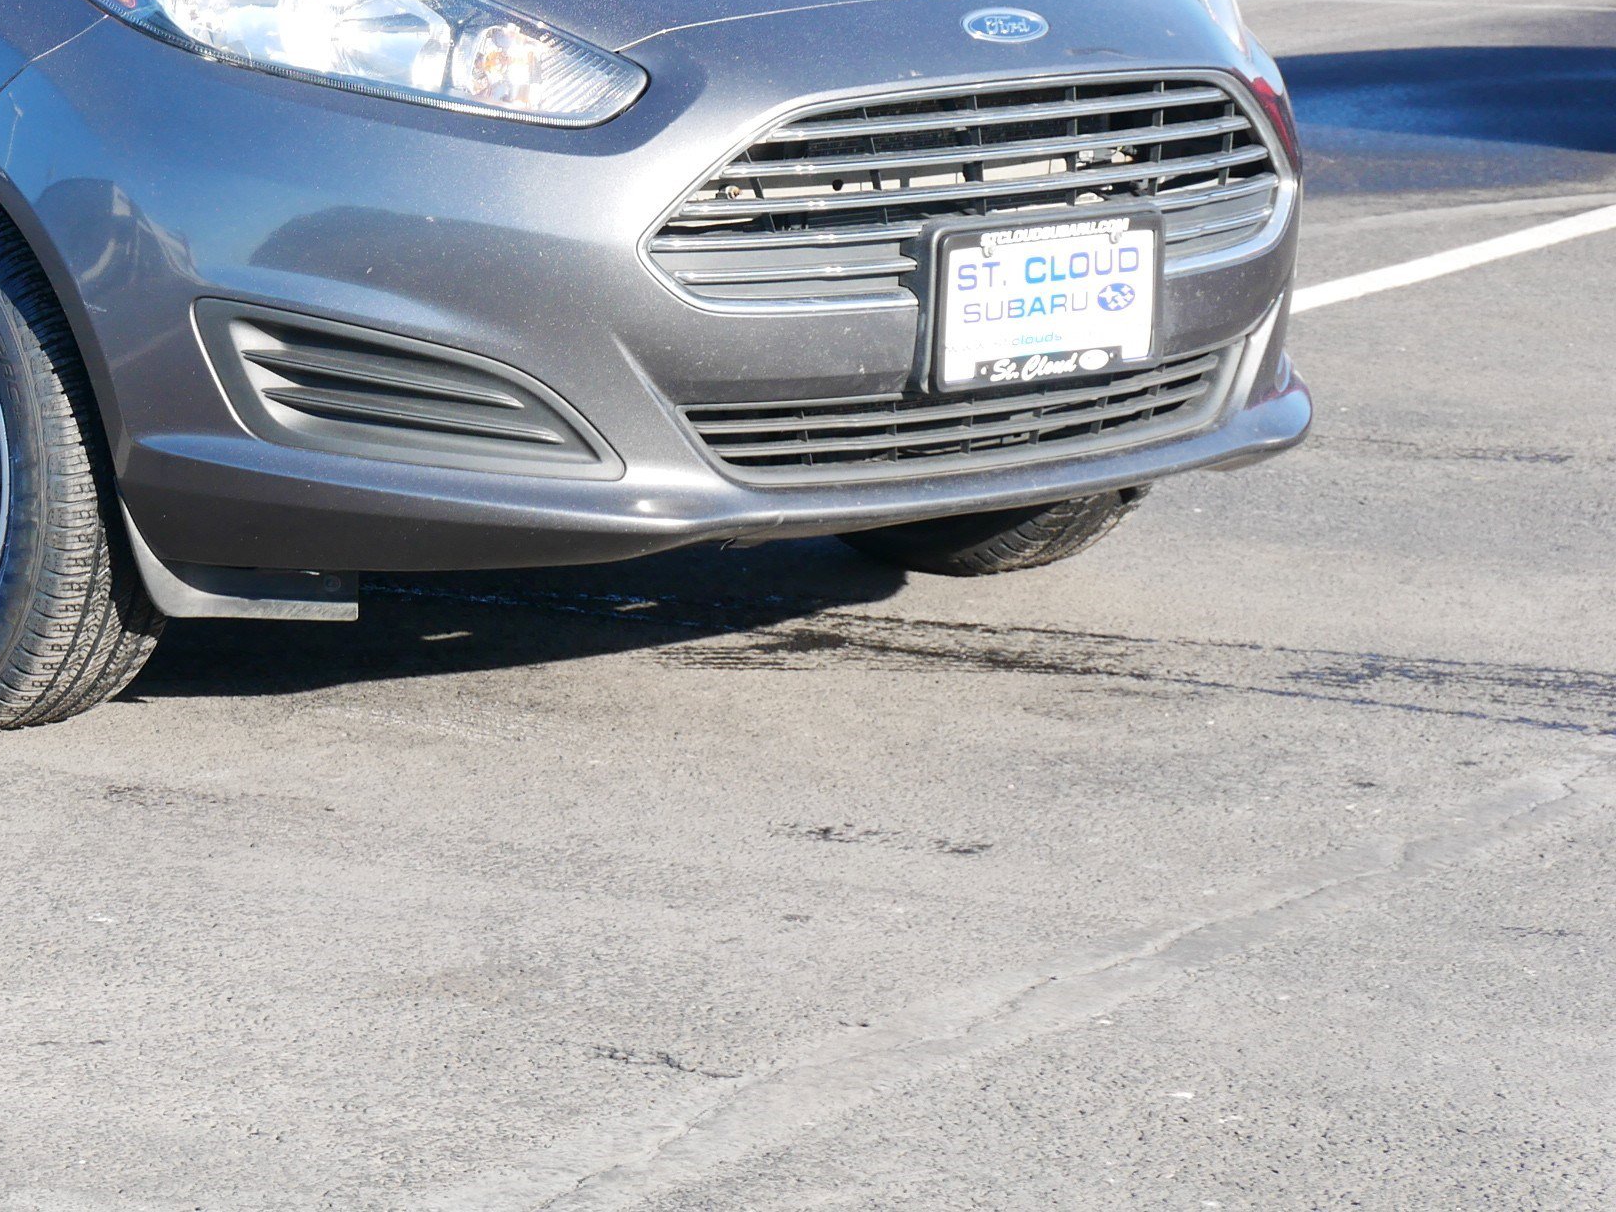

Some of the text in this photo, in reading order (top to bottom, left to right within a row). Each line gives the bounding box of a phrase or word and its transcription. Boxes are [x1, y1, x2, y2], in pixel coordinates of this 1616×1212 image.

[957, 247, 1139, 291] ST. CLOUD
[963, 291, 1089, 324] SUBARU
[1021, 352, 1079, 382] Cloud
